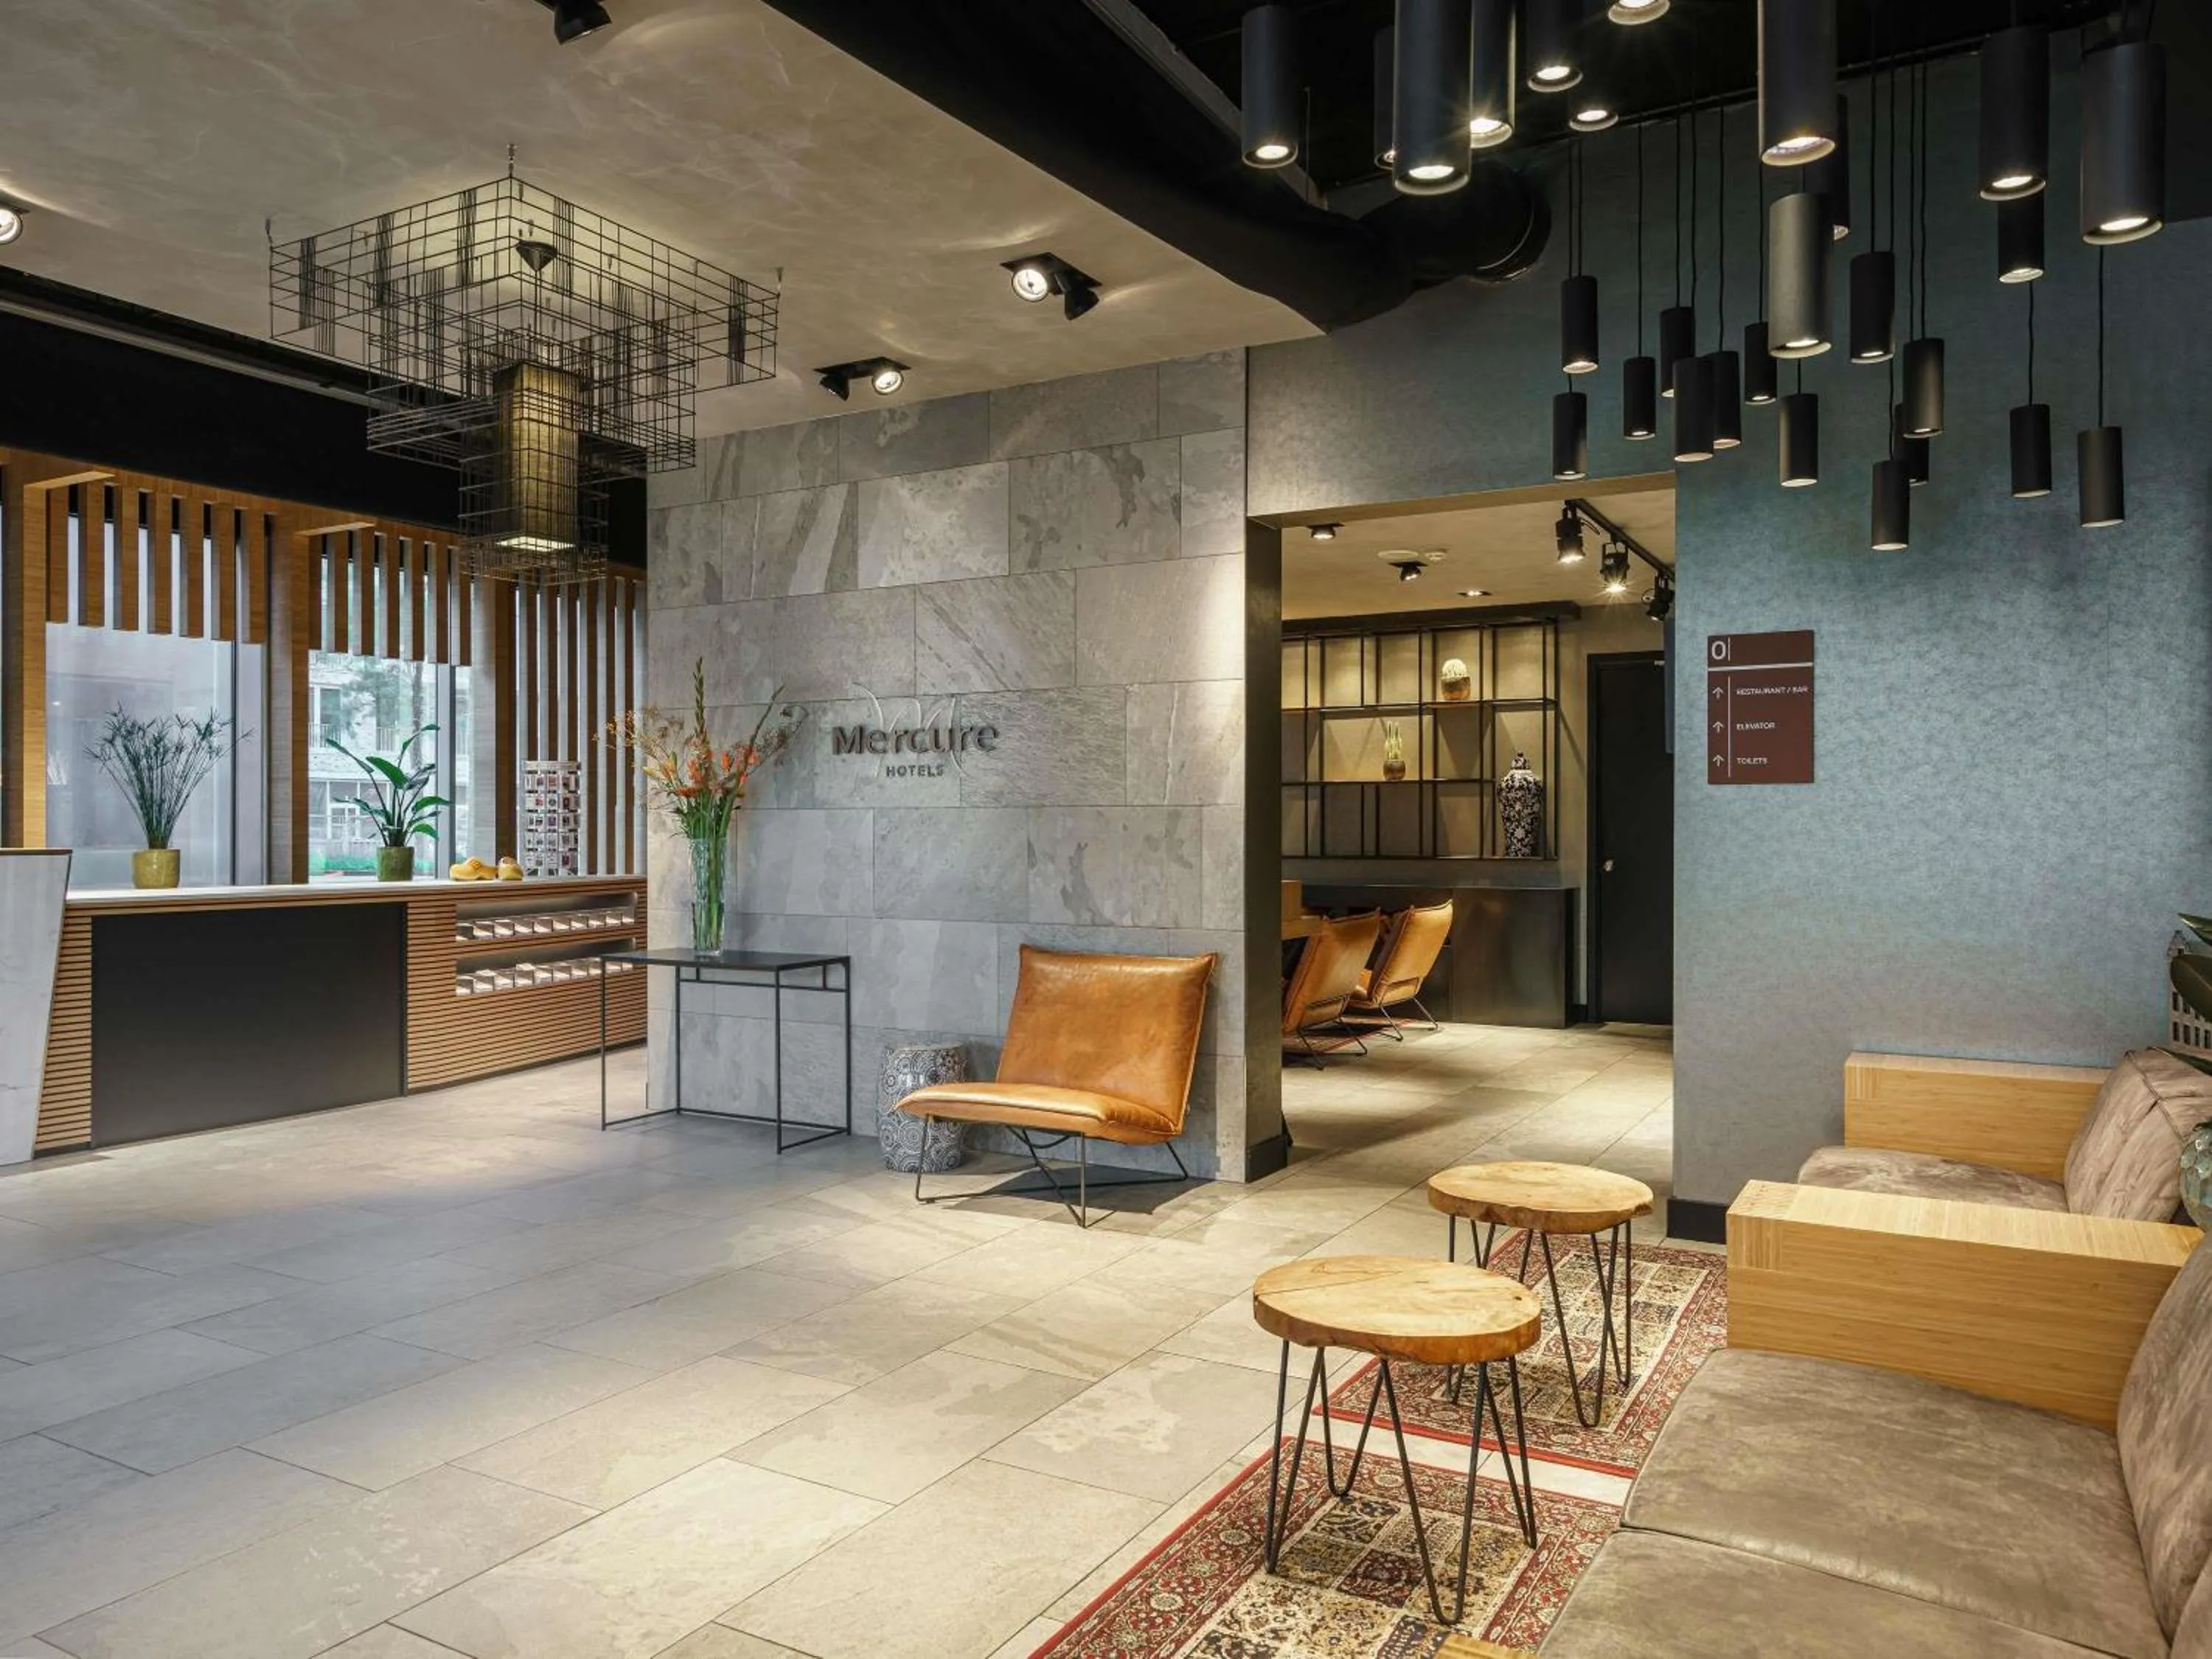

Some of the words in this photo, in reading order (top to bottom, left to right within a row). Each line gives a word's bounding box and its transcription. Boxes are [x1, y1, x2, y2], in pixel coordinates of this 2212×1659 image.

[1736, 687, 1786, 695] RESTAURANT
[1736, 722, 1775, 731] ELEVATOR
[831, 725, 1000, 755] Mercure
[886, 765, 944, 777] HOTELS
